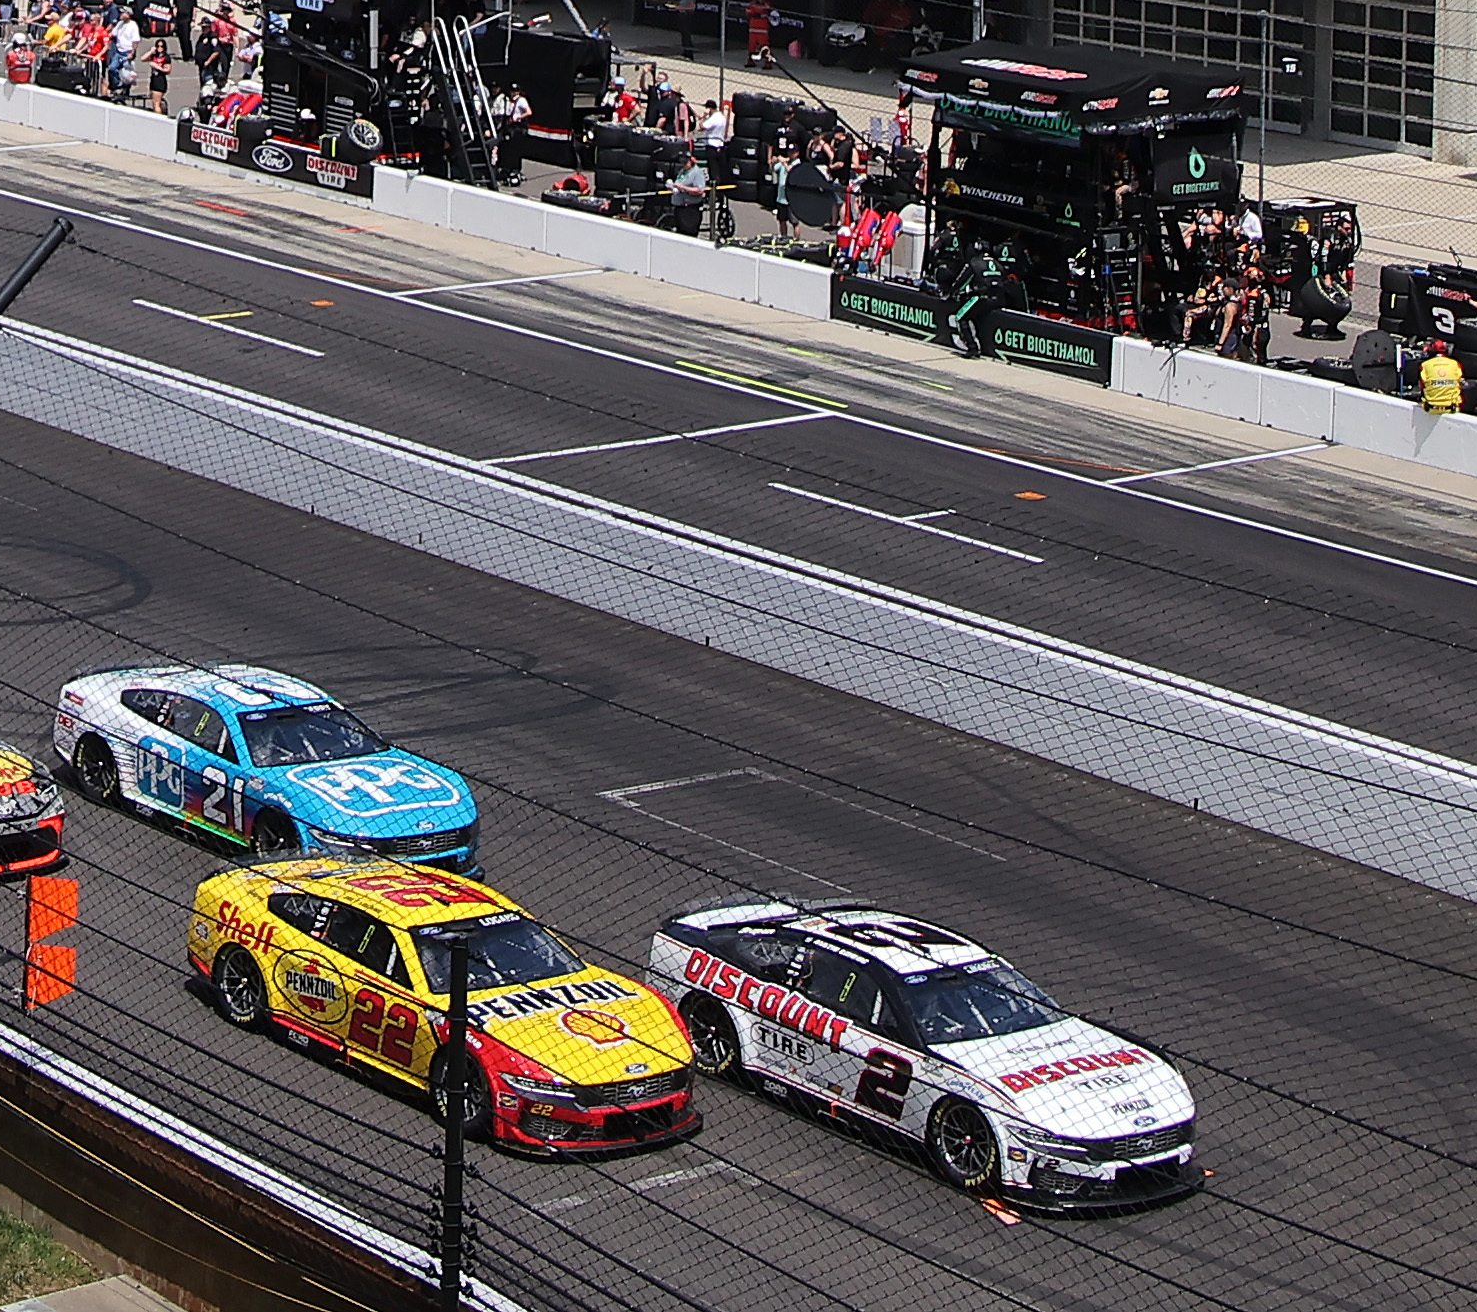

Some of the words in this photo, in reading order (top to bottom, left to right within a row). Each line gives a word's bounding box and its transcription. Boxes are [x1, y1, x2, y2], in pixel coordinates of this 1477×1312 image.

[191, 128, 239, 152] DISCOUNT
[259, 149, 286, 168] Ford
[307, 157, 358, 180] DISCOUNT
[321, 174, 343, 186] TIRE
[961, 184, 1024, 207] WINCHESTER
[850, 292, 871, 312] GET
[871, 297, 937, 328] BIOETHANOL
[1431, 306, 1455, 335] 3
[1005, 329, 1027, 349] GET
[1027, 333, 1099, 367] BIOETHANOL
[138, 743, 181, 799] PPG
[305, 763, 448, 804] PPG
[201, 766, 246, 835] 21
[217, 900, 278, 955] Shell
[479, 912, 521, 928] LOGANO
[285, 970, 339, 1001] PENNZOIL
[684, 948, 851, 1053] DISCOUNT
[467, 979, 641, 1027] PENNZOIL
[348, 987, 419, 1067] 22
[758, 1026, 809, 1060] TIRE
[854, 1047, 913, 1122] 2
[997, 1048, 1156, 1094] DISCOUNT
[1075, 1073, 1129, 1091] TIRE
[530, 1102, 554, 1117] 22
[1111, 1098, 1152, 1116] PENNZOIL
